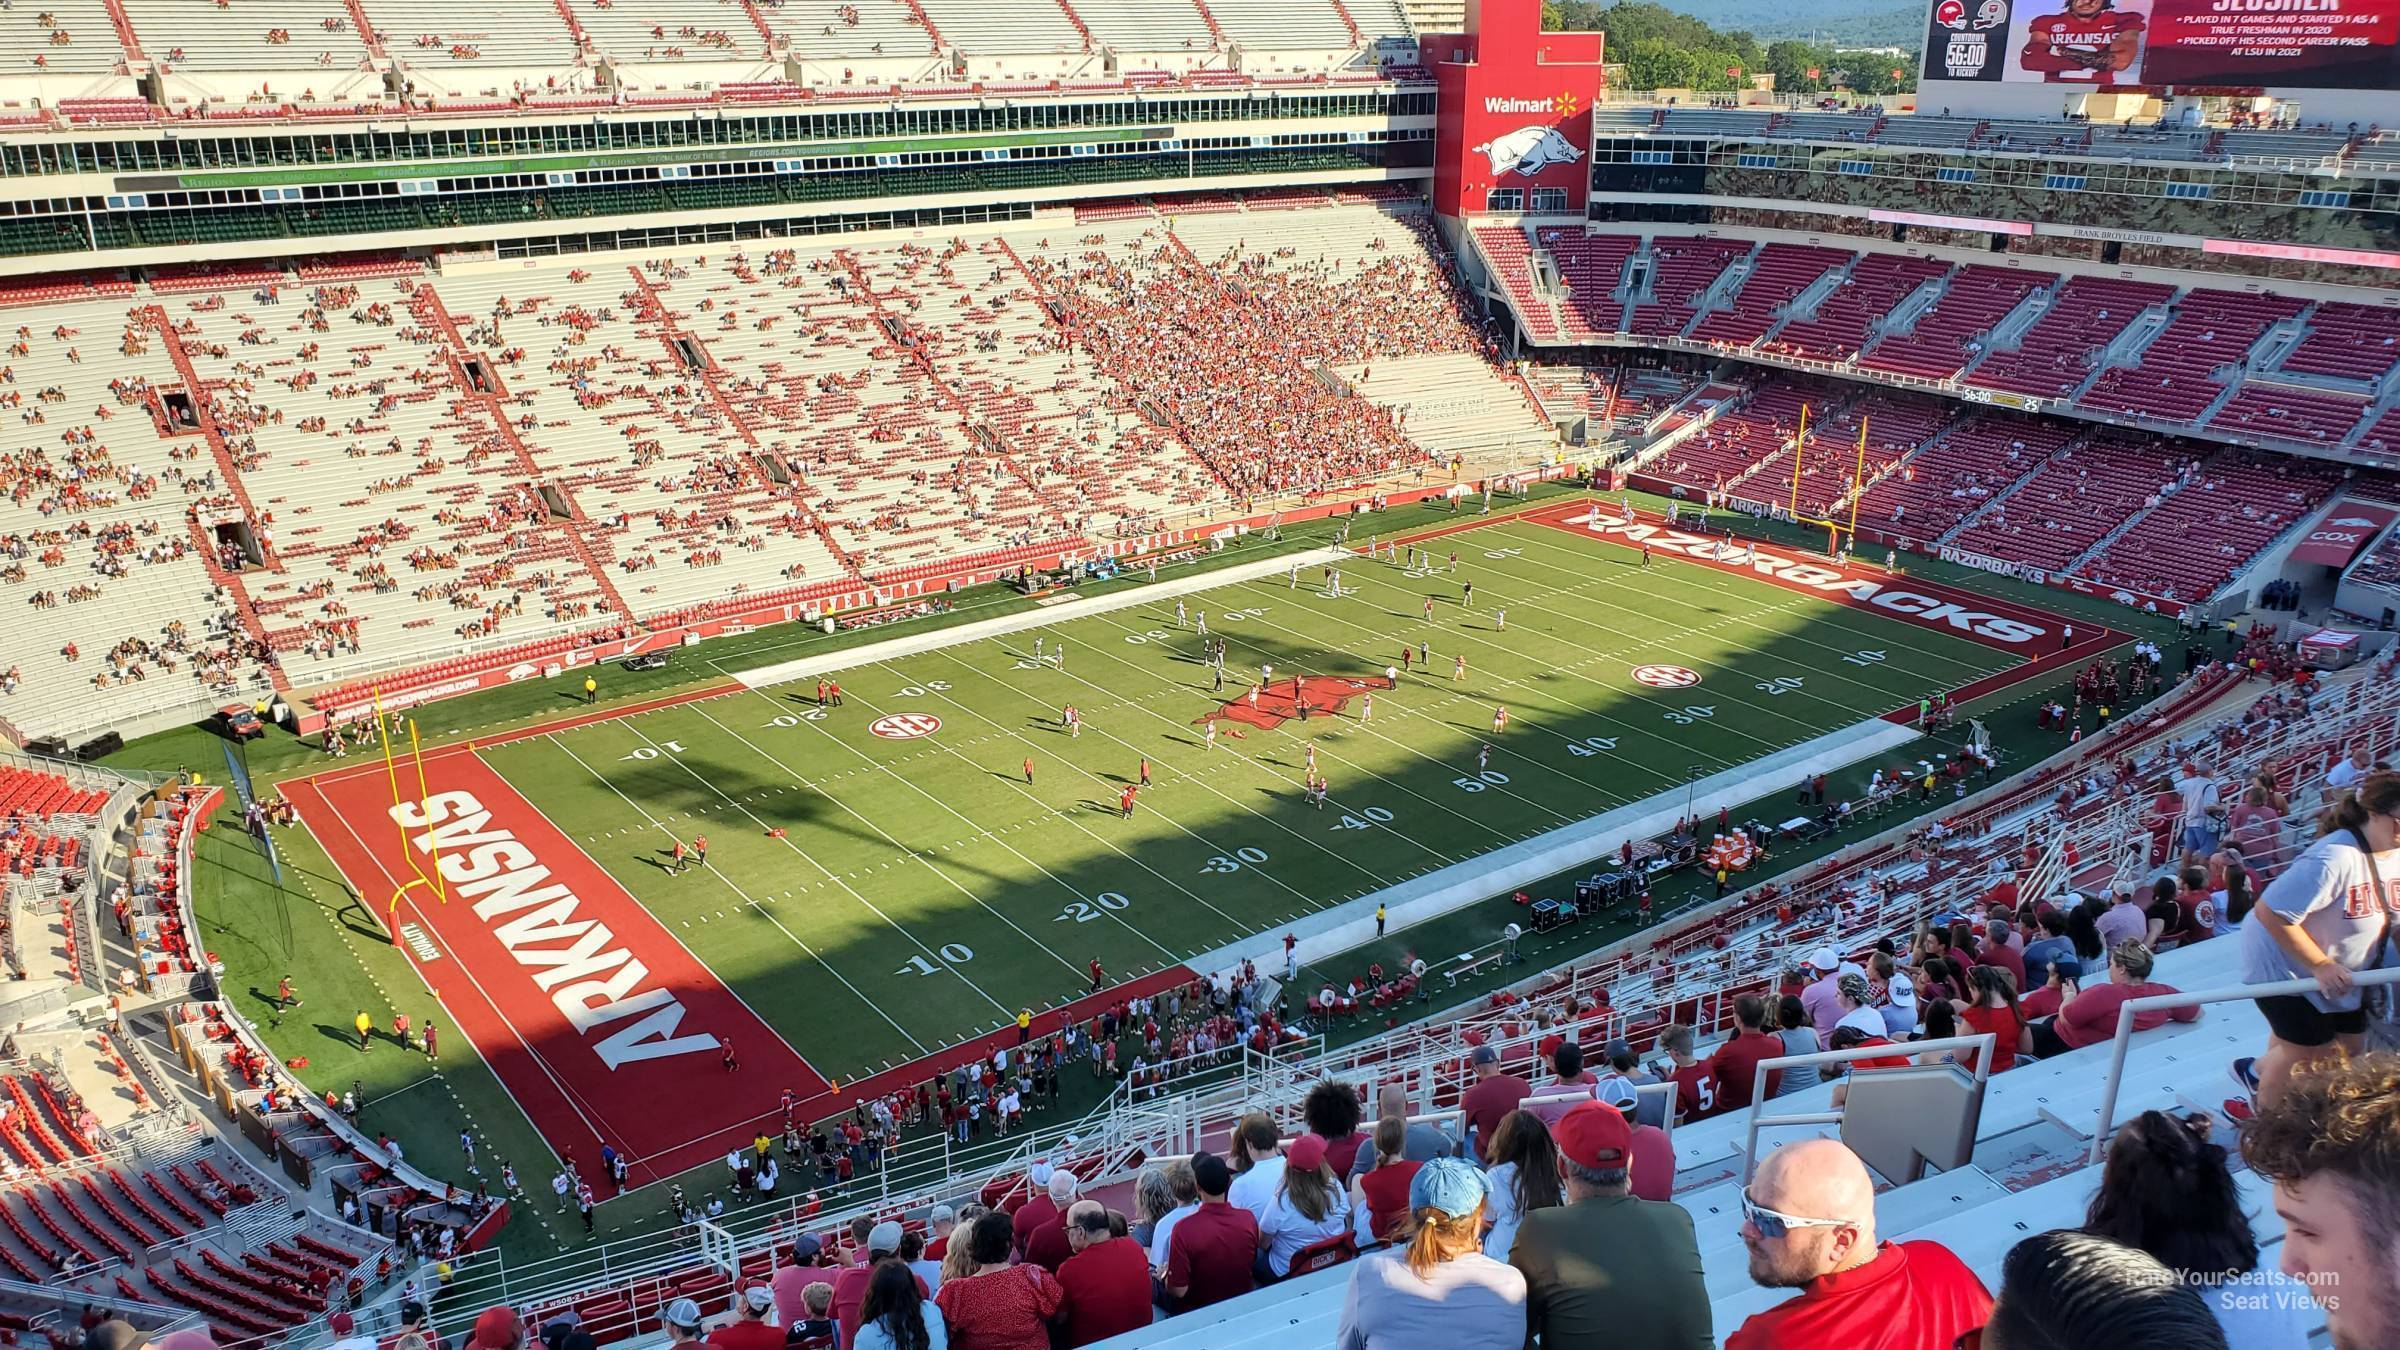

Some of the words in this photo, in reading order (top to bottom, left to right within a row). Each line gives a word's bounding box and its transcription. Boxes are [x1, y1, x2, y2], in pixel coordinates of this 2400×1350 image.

[2184, 16, 2218, 24] PLAYED
[2220, 16, 2230, 24] IN
[2241, 16, 2274, 24] GAMES
[2277, 16, 2297, 24] AND
[2299, 16, 2343, 24] STARTED
[2351, 16, 2367, 24] AS
[2368, 16, 2379, 24] A
[2210, 26, 2235, 34] TRUE
[2237, 26, 2289, 34] FRESHMAN
[2291, 26, 2302, 34] IN
[2304, 26, 2332, 35] 2020
[2184, 37, 2217, 45] PICKED
[2219, 37, 2237, 45] OFF
[2239, 37, 2256, 45] HIS
[2257, 37, 2297, 45] SECOND
[2298, 37, 2338, 46] CAREER
[2340, 38, 2369, 46] PASS
[2230, 48, 2242, 56] AT
[2244, 48, 2264, 56] LSU
[2265, 48, 2276, 56] IN
[2277, 48, 2302, 56] 2021
[1948, 45, 1984, 66] 56:00
[1956, 69, 1978, 77] KICKOFF
[1484, 96, 1553, 113] Walmart
[2073, 228, 2100, 238] FRANK
[2101, 231, 2138, 241] BROYLES
[2139, 233, 2163, 243] FIELD
[1964, 388, 1991, 403] 56:00
[2024, 399, 2038, 411] 25
[2310, 531, 2360, 543] COX
[1939, 547, 2045, 585] RAZORBACKS
[1561, 512, 2046, 643] RAZORBACKS
[1841, 649, 1885, 668] 10
[1637, 665, 1698, 688] SEC
[1754, 676, 1804, 695] 20
[900, 680, 953, 698] 30
[1663, 704, 1713, 725] 30
[876, 714, 936, 738] SEC
[631, 739, 688, 760] 10
[1566, 736, 1616, 758] 40
[1451, 770, 1512, 794] 50
[1336, 806, 1395, 831] 40
[1204, 846, 1270, 874] 30
[1062, 891, 1130, 925] 20
[388, 790, 722, 1072] ARKANSAS
[907, 943, 975, 978] 10
[1696, 1075, 1713, 1111] 5
[886, 1205, 912, 1215] W08-1
